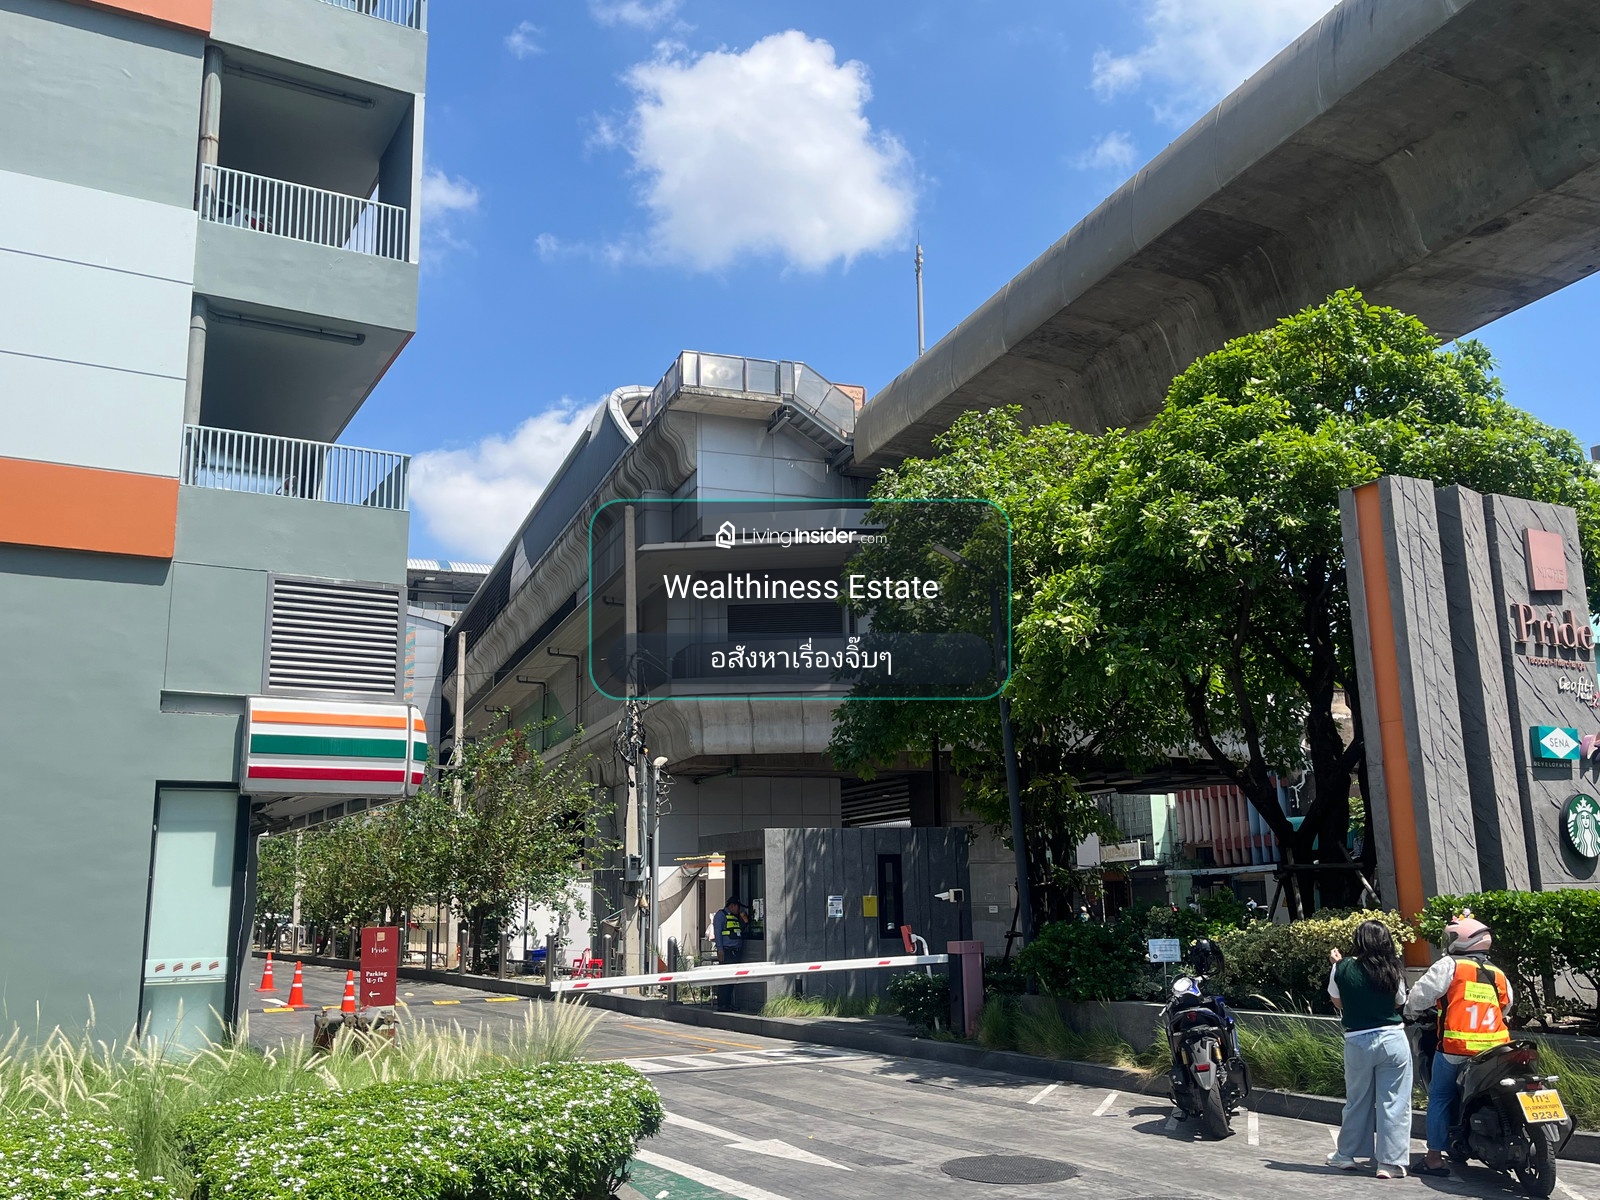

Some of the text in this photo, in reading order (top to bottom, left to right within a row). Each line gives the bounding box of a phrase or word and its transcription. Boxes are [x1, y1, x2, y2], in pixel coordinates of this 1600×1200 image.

[1536, 565, 1565, 581] NICHE
[1510, 602, 1596, 650] Pride
[1549, 737, 1570, 748] SENA
[1465, 1004, 1496, 1030] 14
[1532, 1111, 1560, 1120] 9234
